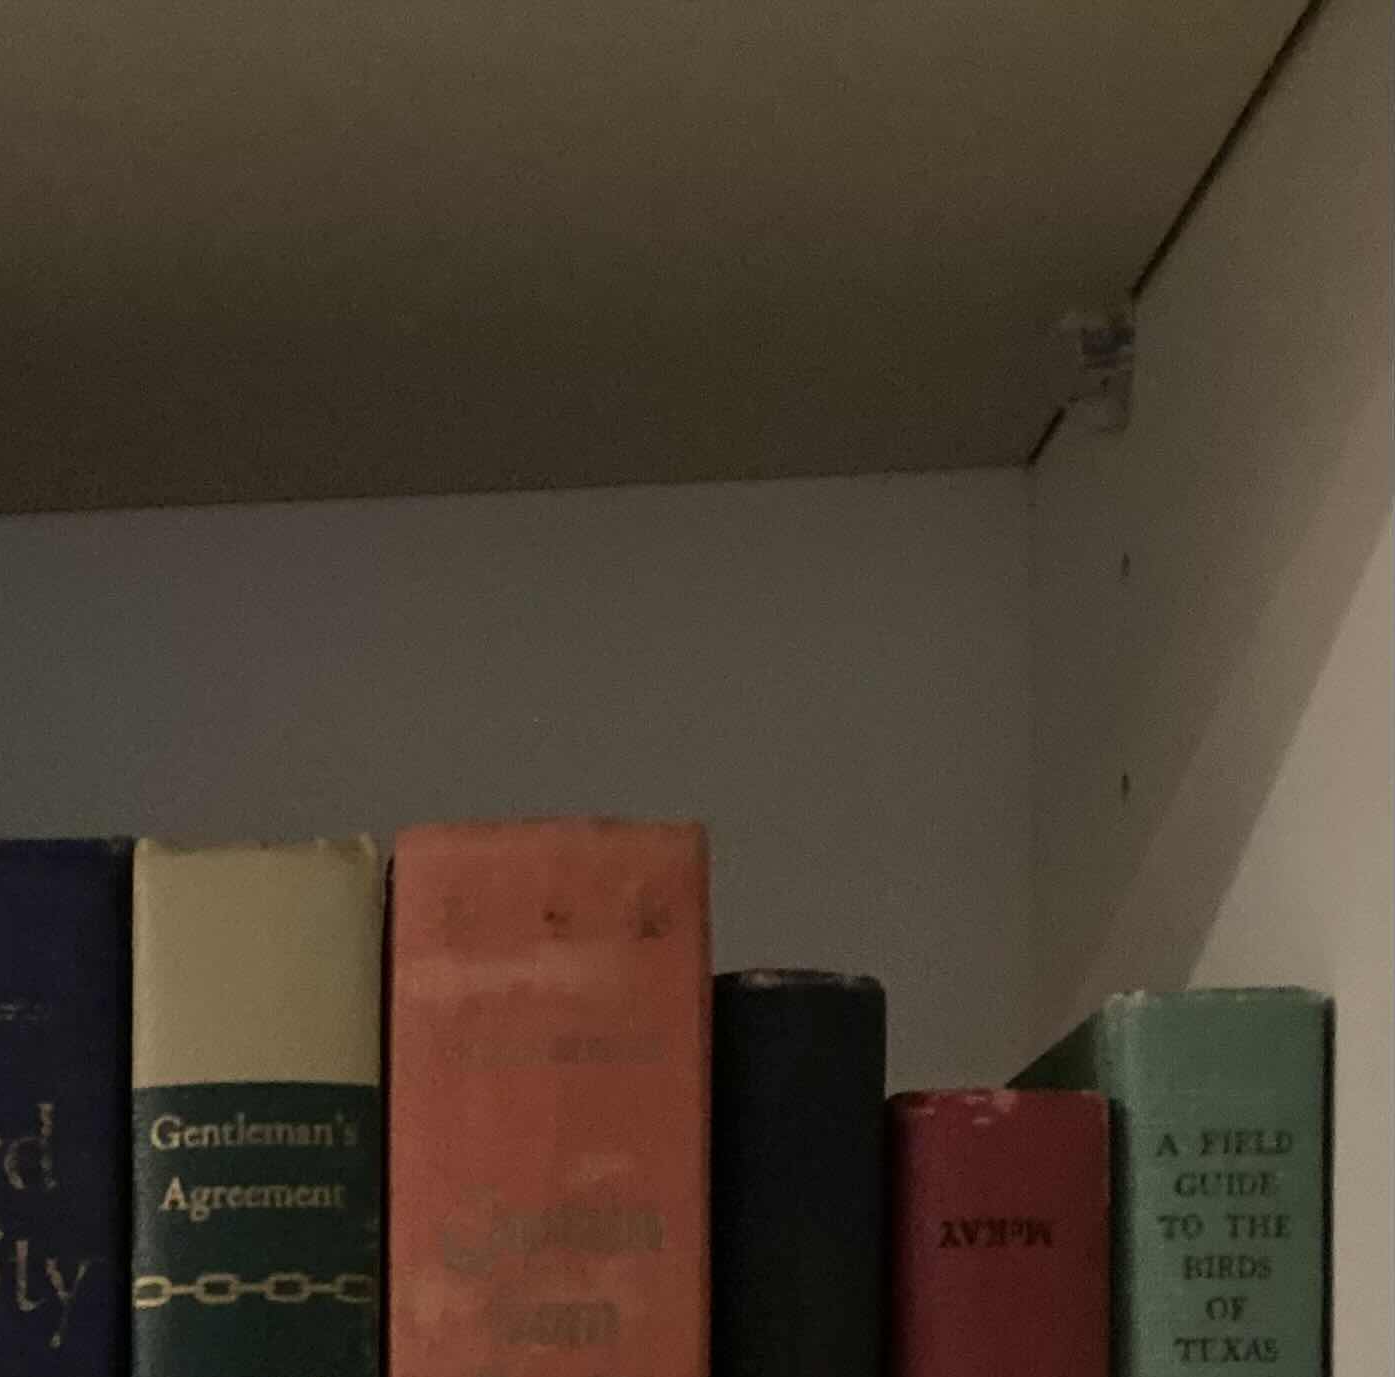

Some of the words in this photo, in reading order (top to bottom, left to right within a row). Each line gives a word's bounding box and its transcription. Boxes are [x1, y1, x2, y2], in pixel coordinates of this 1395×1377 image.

[149, 1110, 359, 1152] Gentleman's
[1156, 1132, 1180, 1159] A
[1198, 1128, 1294, 1156] FIELD
[158, 1174, 348, 1223] Agreement
[1173, 1171, 1277, 1199] GUIDE
[1157, 1213, 1204, 1242] TO
[1225, 1213, 1292, 1242] THE
[1181, 1254, 1273, 1282] BIRDS
[1204, 1295, 1248, 1322] OF
[1173, 1337, 1280, 1365] TEXAS
